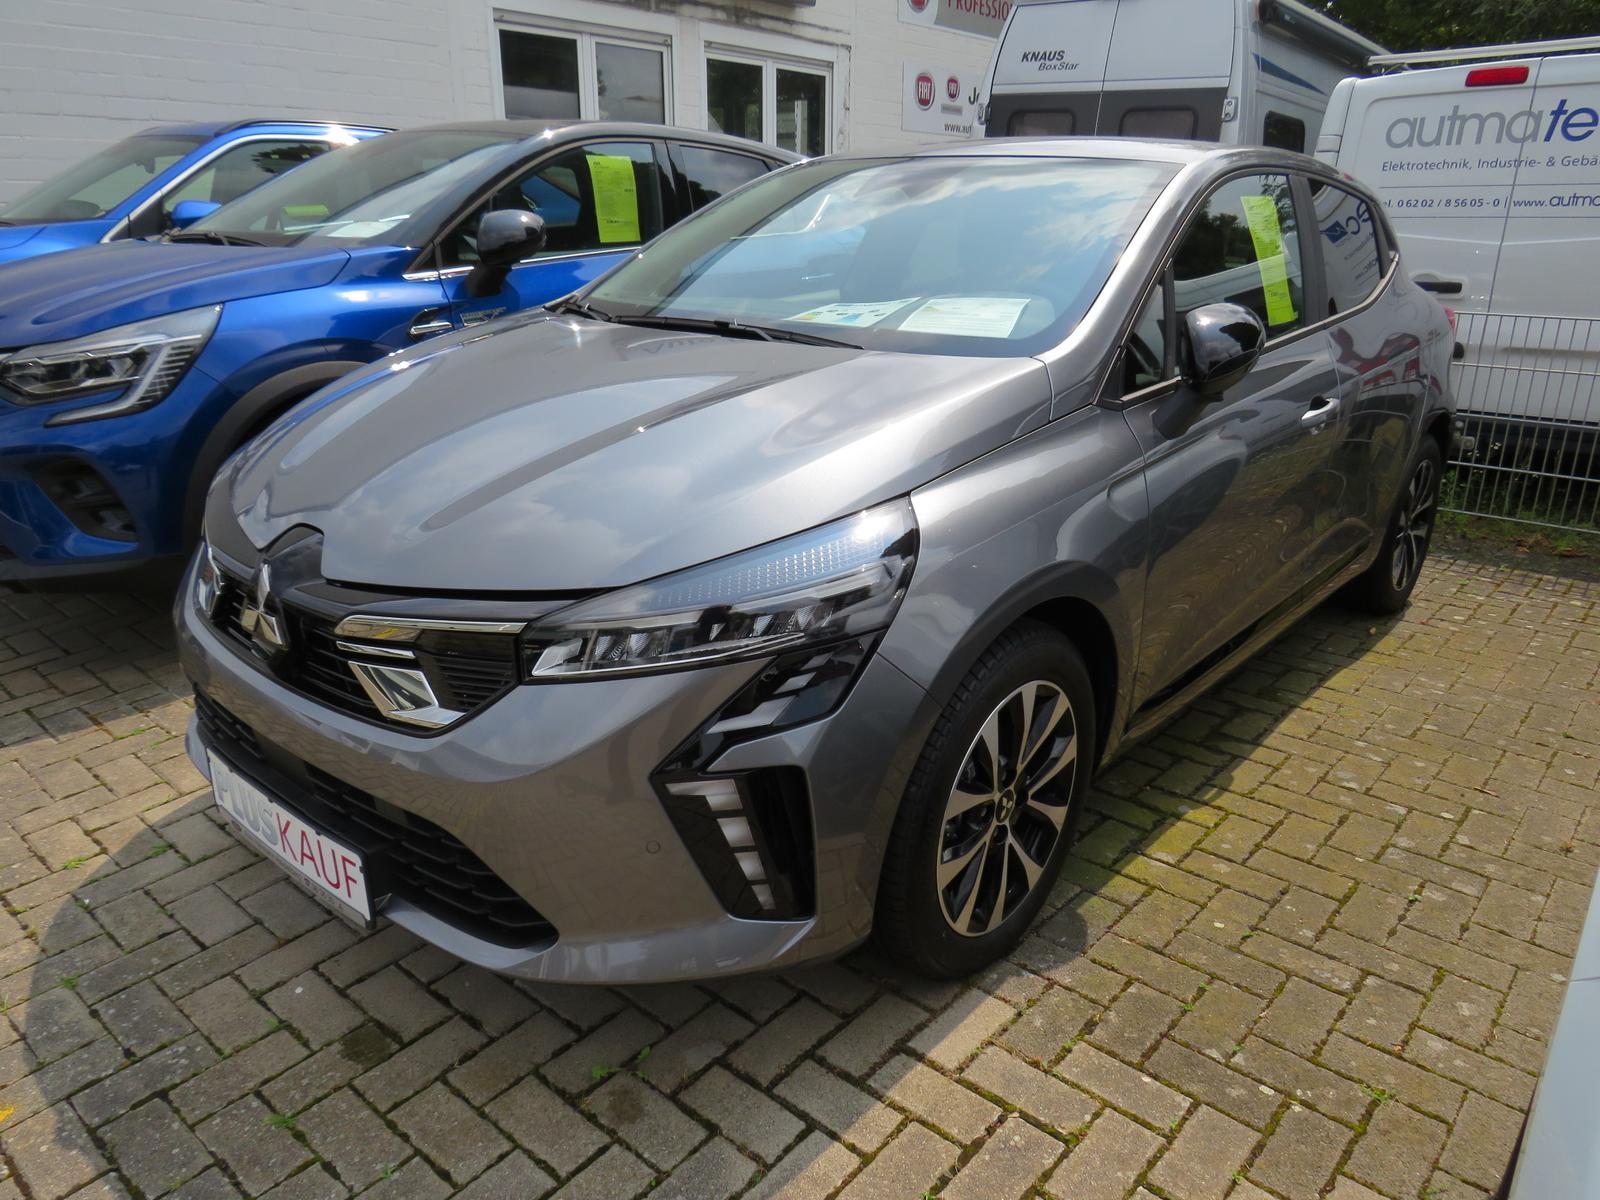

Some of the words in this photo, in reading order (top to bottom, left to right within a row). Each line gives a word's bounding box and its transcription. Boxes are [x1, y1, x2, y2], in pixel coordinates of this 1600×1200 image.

[948, 0, 1013, 21] ROFESSIO
[1021, 50, 1065, 62] KNAUS
[1038, 61, 1080, 71] BoxStar
[918, 81, 931, 100] FIAT
[968, 87, 980, 105] J
[1382, 158, 1472, 172] Elektrotechnik,
[1477, 157, 1541, 169] Industrie-
[1546, 156, 1556, 167] &
[1561, 155, 1600, 167] Gebä
